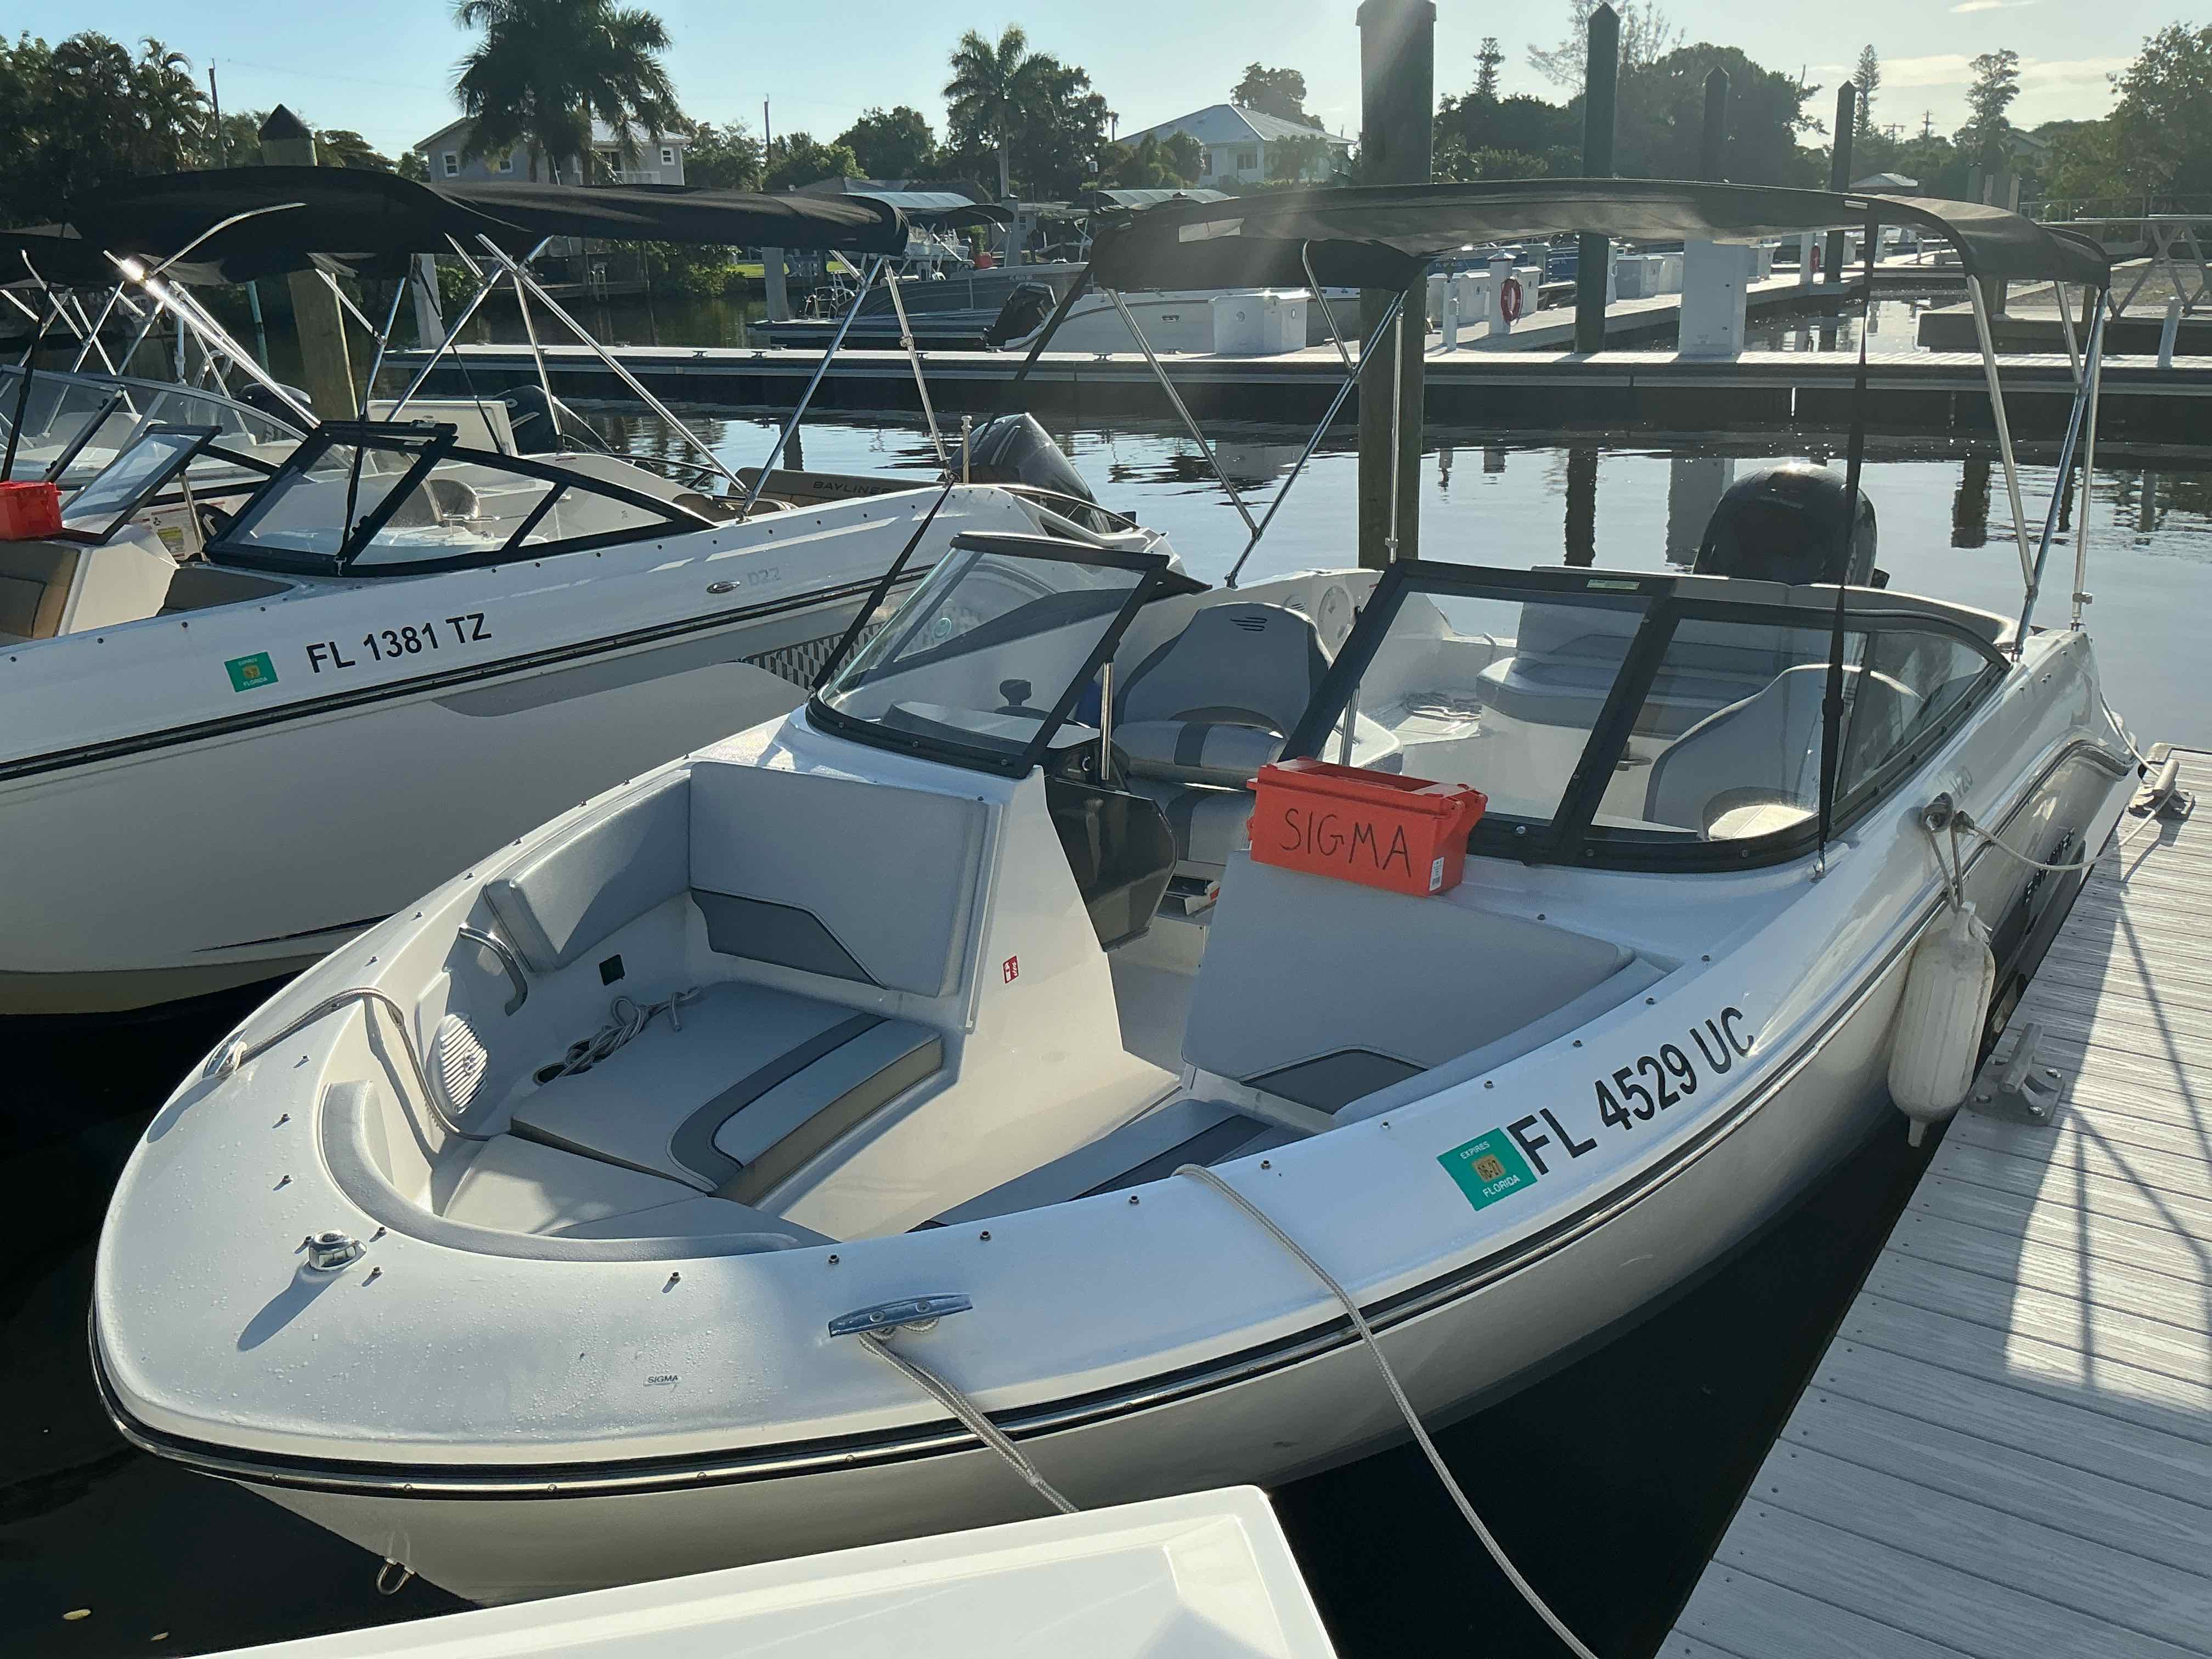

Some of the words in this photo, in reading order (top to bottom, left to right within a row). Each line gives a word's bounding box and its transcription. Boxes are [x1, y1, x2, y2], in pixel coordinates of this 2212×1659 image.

[306, 641, 356, 674] FL
[363, 622, 439, 661] 1381
[445, 612, 492, 644] TZ
[1280, 808, 1412, 878] SIGMA
[1506, 1108, 1598, 1176] FL
[1595, 1043, 1698, 1131] 4529
[1689, 1006, 1754, 1075] UC
[1459, 1141, 1491, 1159] EXPIRES
[1482, 1174, 1521, 1198] FLORIDA
[647, 1374, 679, 1383] SIGMA
